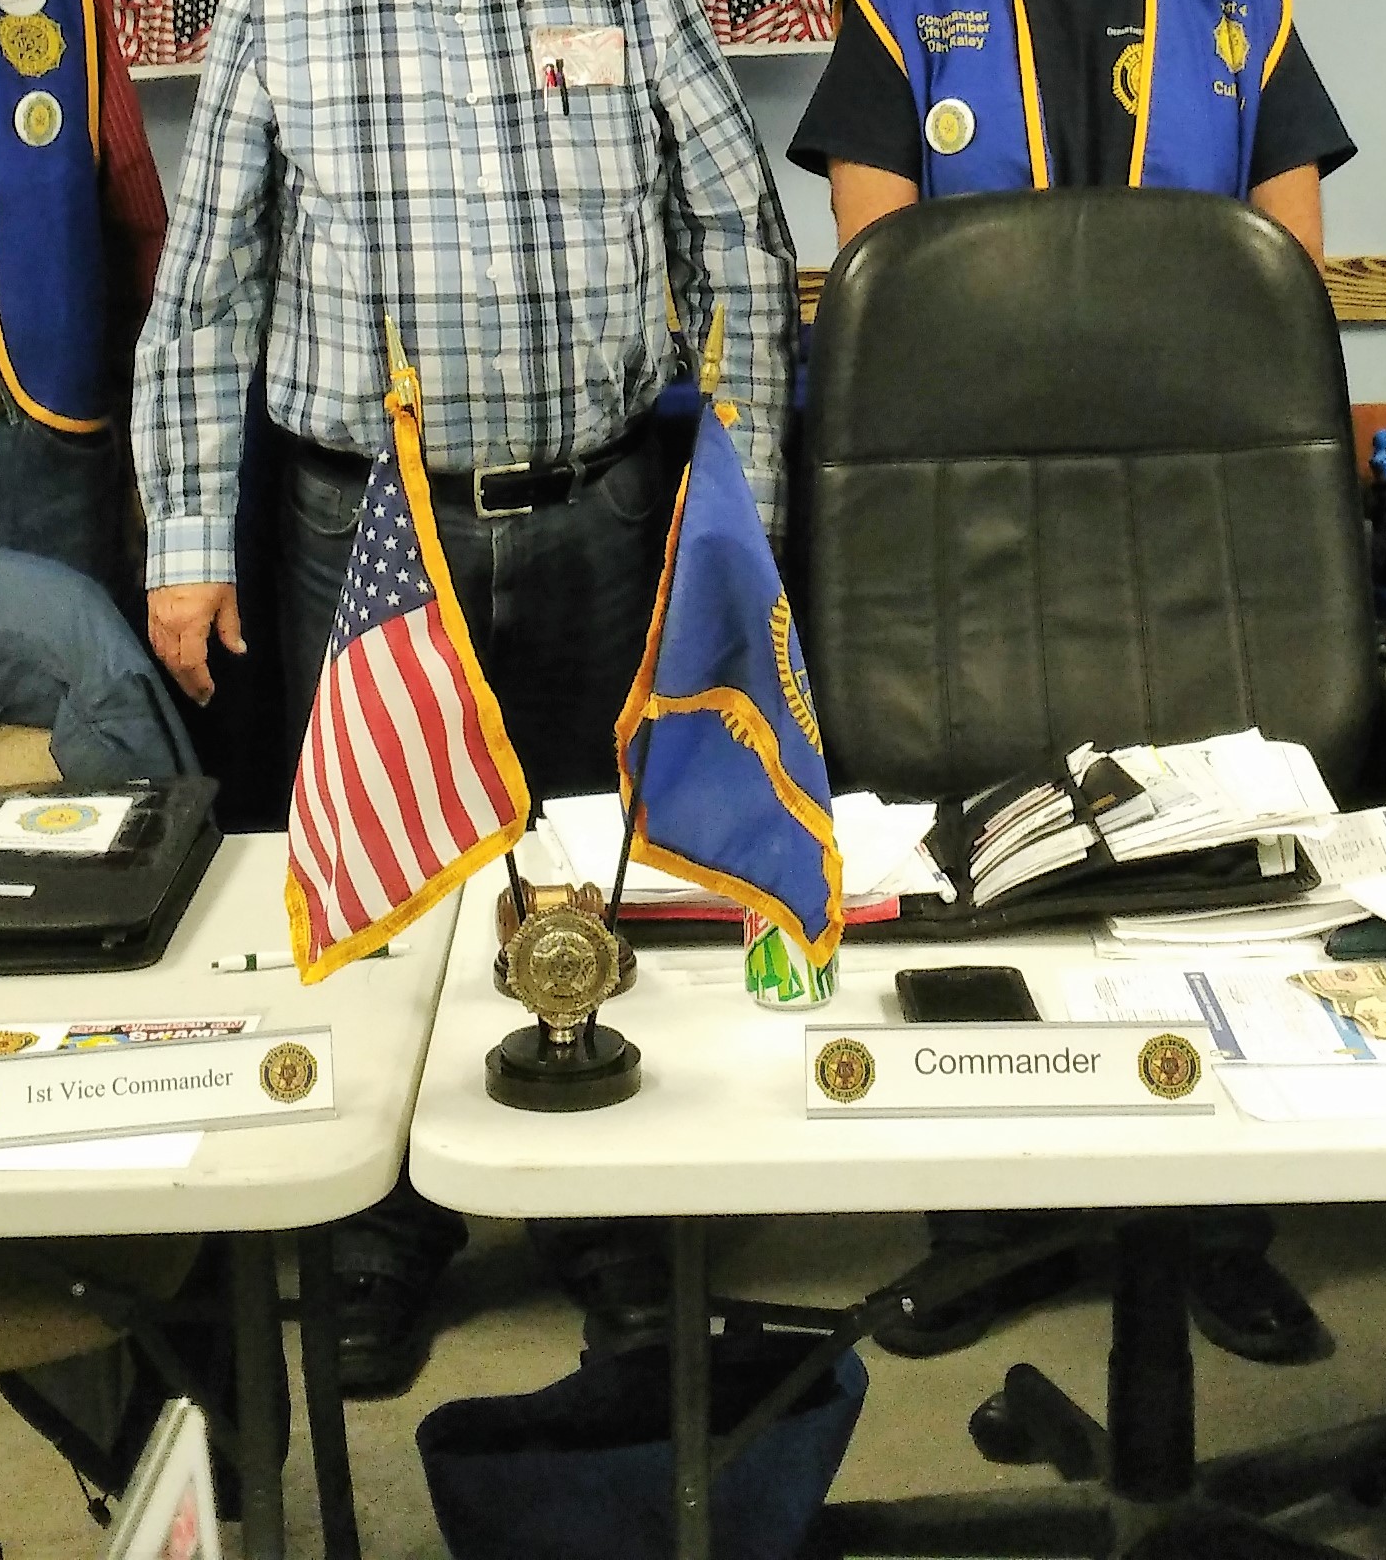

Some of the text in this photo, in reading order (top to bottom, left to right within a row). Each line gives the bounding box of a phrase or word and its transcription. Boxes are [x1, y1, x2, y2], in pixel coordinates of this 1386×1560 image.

[916, 10, 989, 28] Commander
[918, 25, 941, 42] Life
[913, 1046, 1102, 1078] Commander
[25, 1068, 234, 1106] 1st Vice Commander
